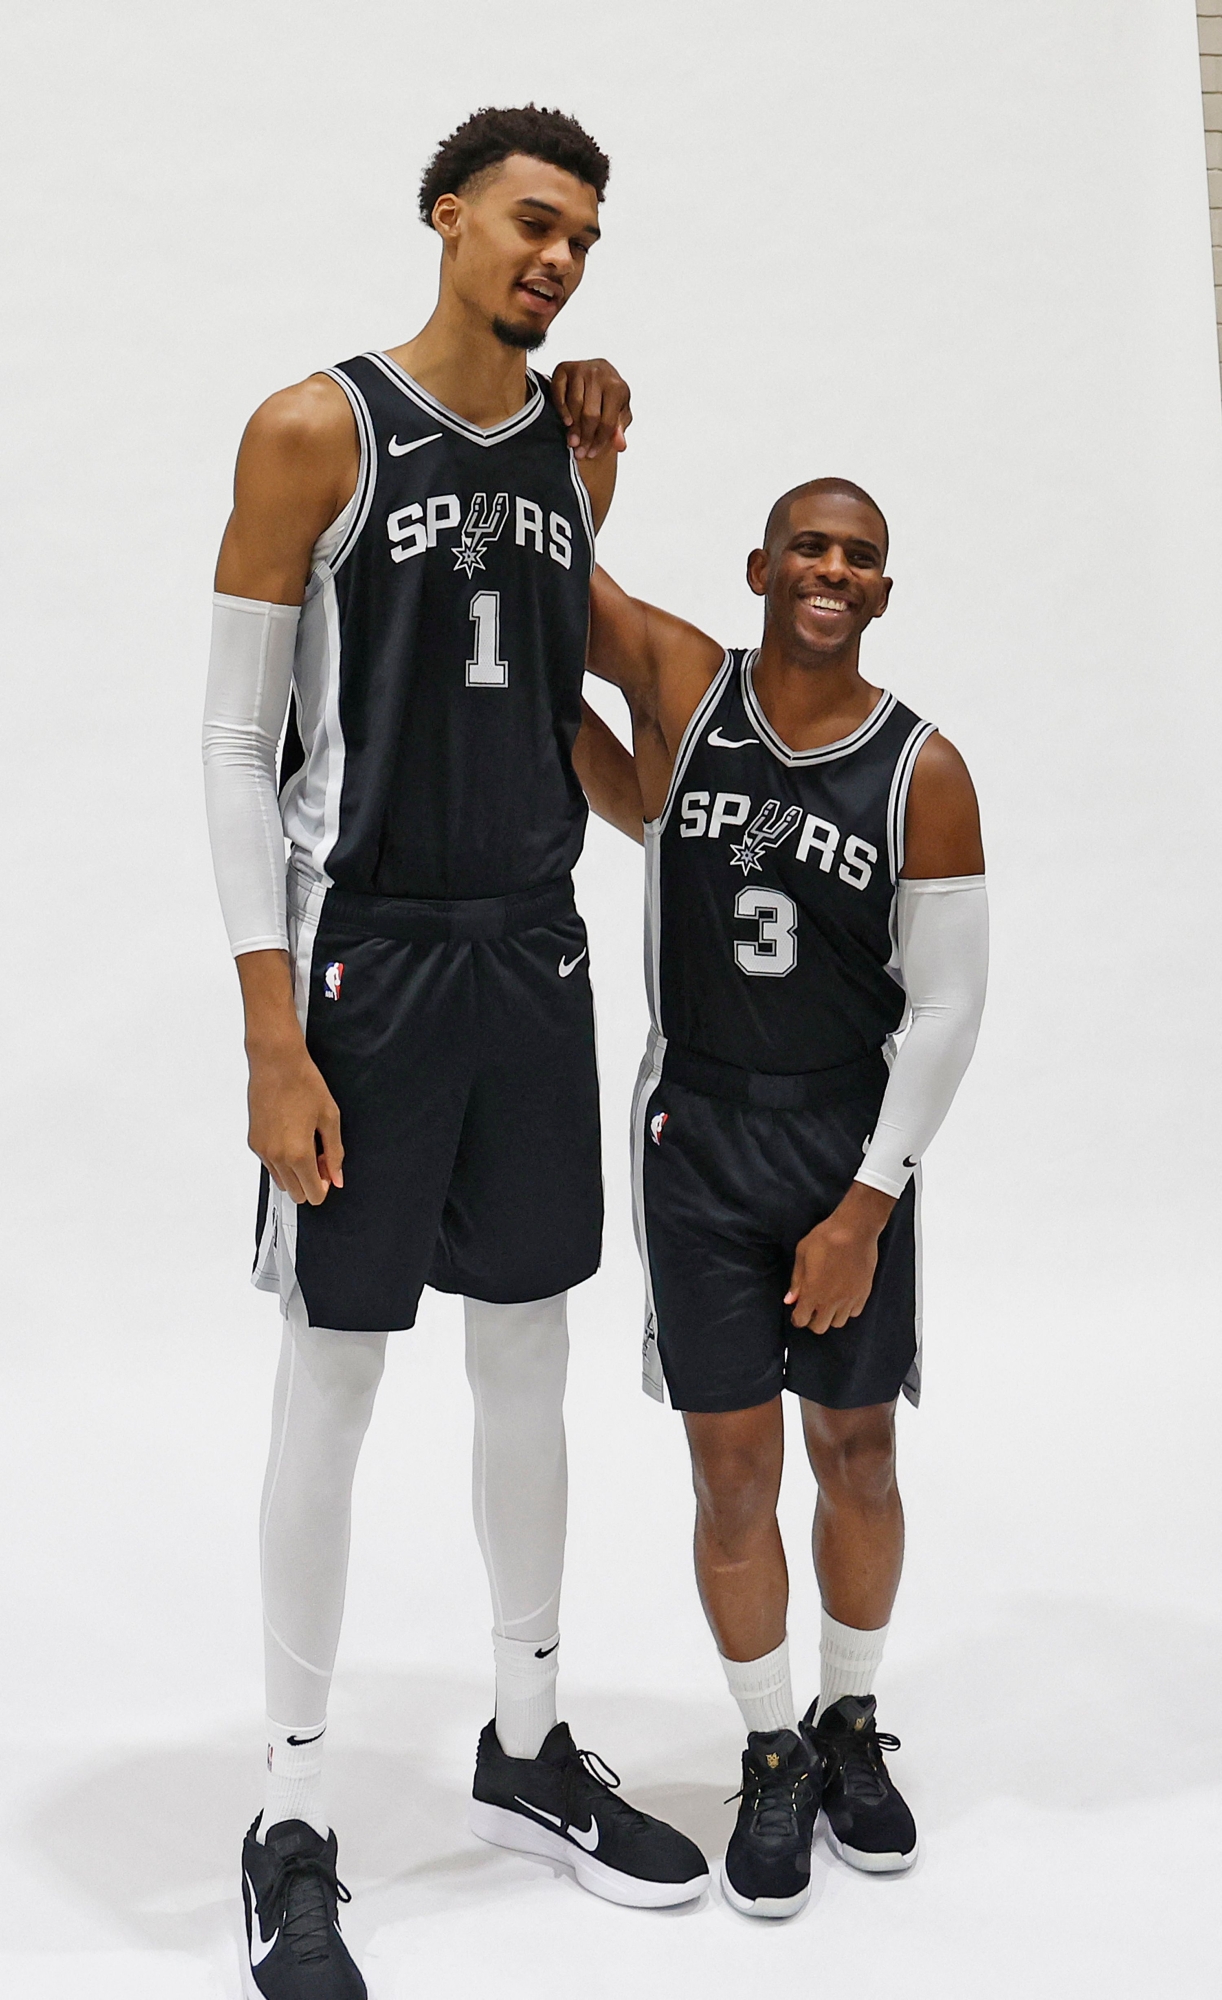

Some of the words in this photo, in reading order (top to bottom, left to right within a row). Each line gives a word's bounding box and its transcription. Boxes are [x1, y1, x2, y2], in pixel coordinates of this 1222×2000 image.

[386, 492, 572, 578] SPURS
[465, 590, 508, 688] 1
[679, 791, 878, 891] SPURS
[733, 885, 798, 978] 3
